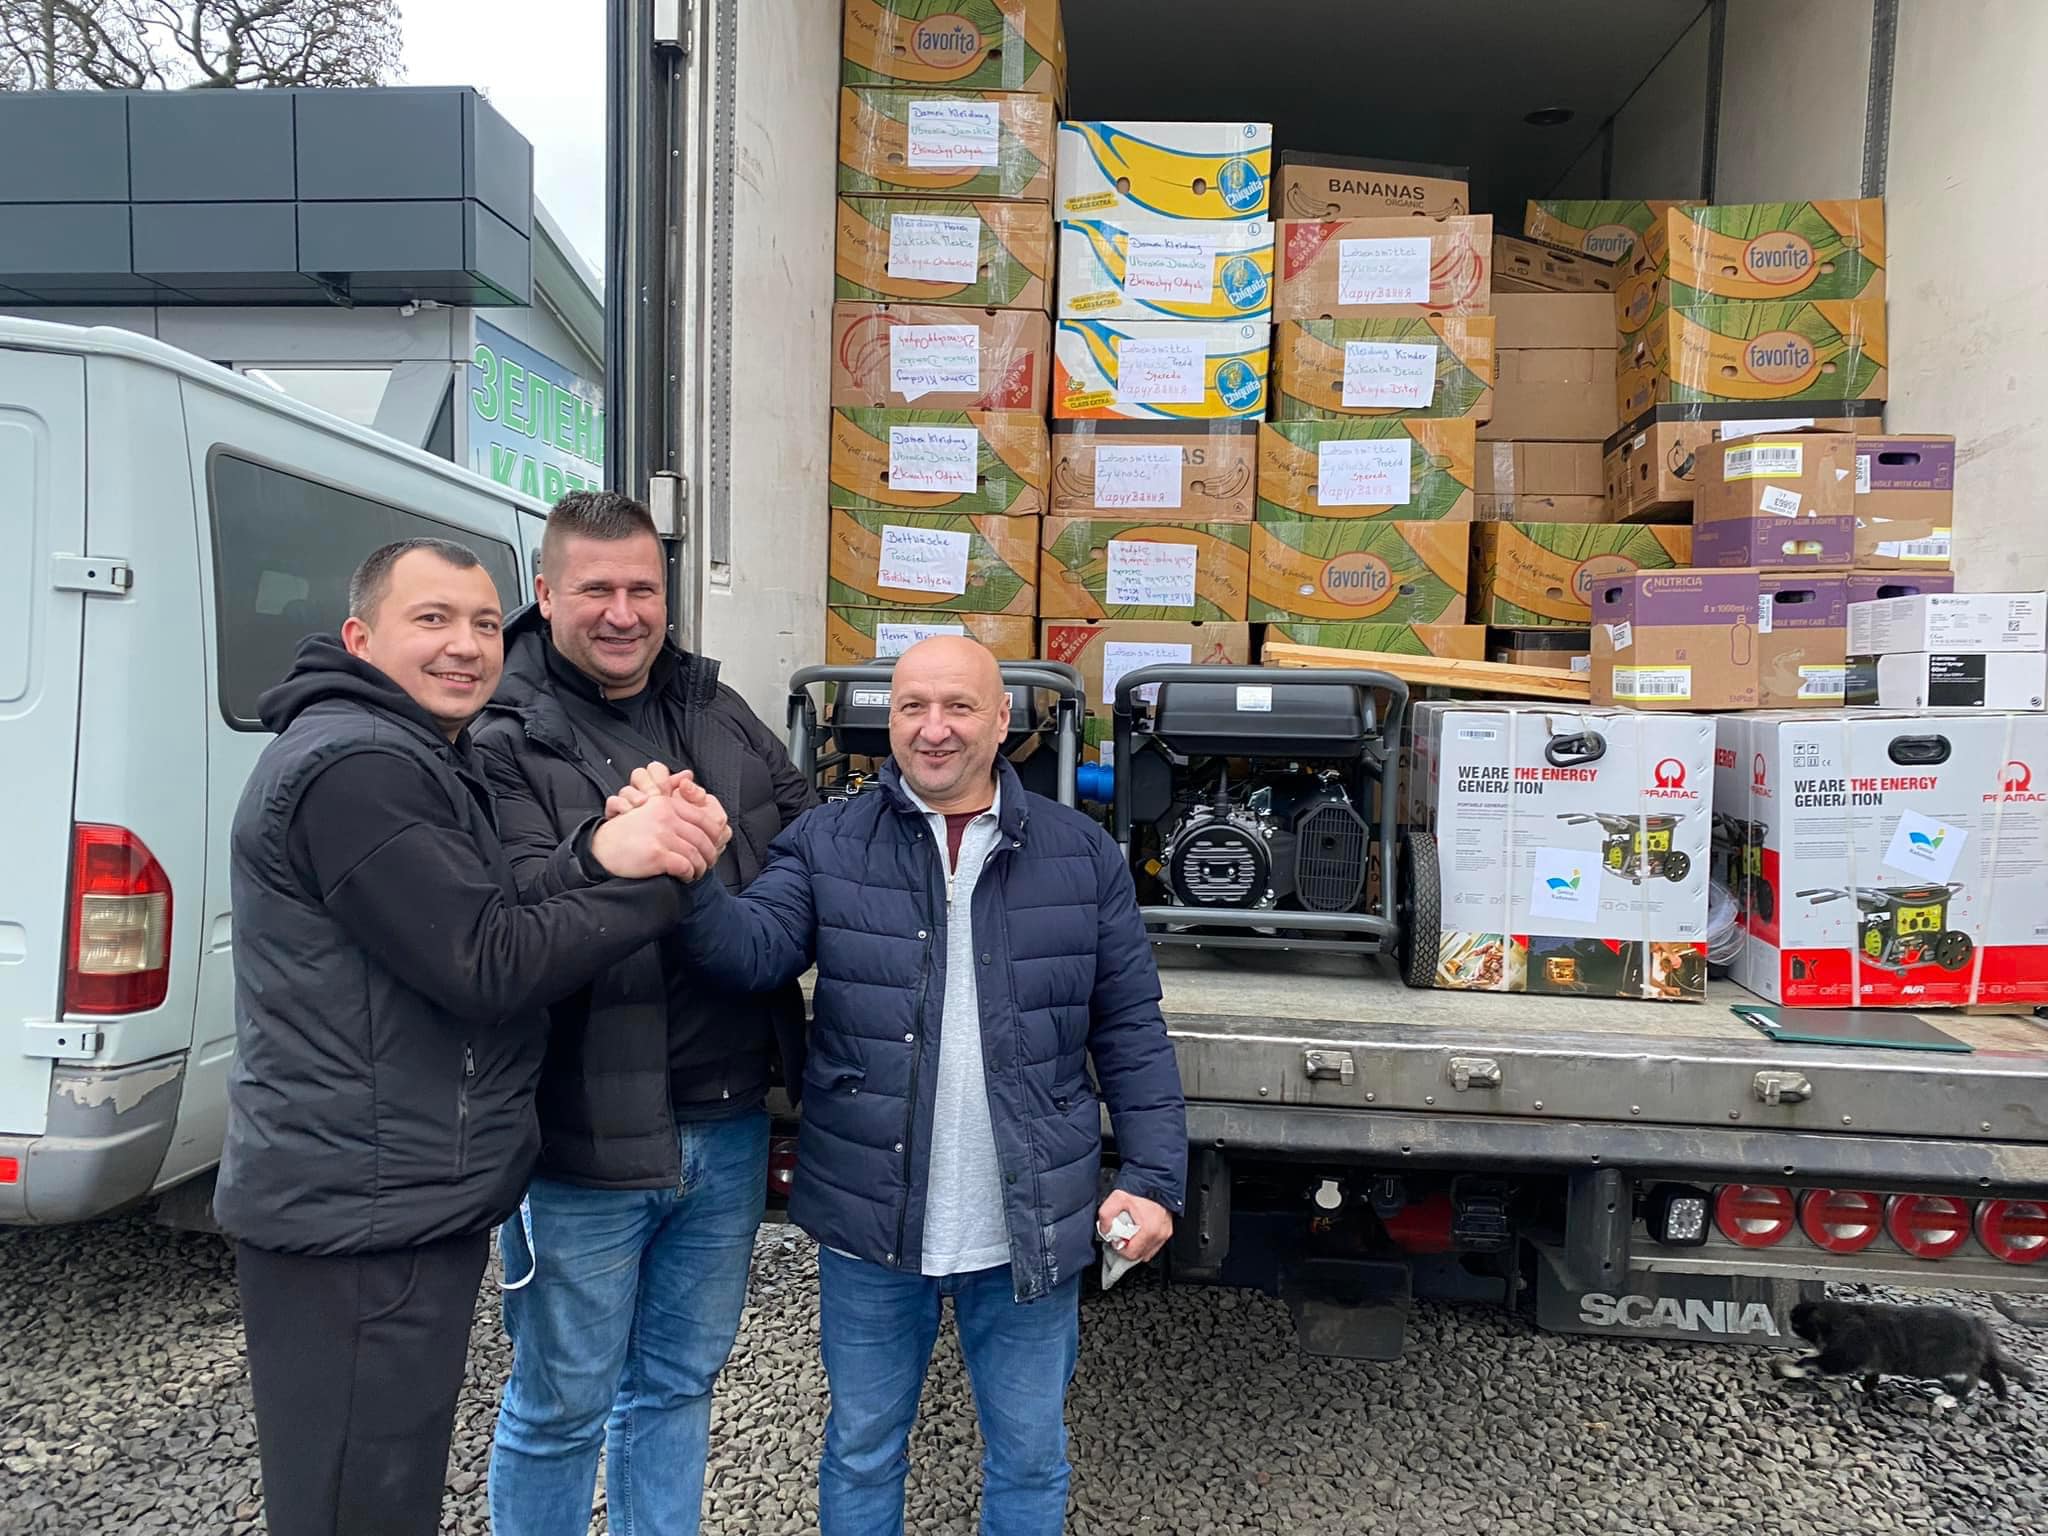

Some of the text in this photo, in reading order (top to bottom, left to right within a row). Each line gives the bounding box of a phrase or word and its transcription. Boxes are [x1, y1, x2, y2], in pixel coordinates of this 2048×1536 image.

[918, 27, 976, 54] favorita
[1226, 179, 1264, 207] Chiquita
[1328, 179, 1425, 201] BANANAS
[1385, 199, 1424, 209] ORGANIC
[1750, 246, 1808, 270] favorita
[1229, 277, 1267, 306] Chiquita
[1750, 345, 1809, 369] favorita
[1223, 379, 1261, 405] Chiquita
[472, 343, 604, 468] ЗЕЛЕН
[490, 442, 602, 508] КАР
[1327, 565, 1387, 591] favorita
[1654, 576, 1703, 587] NUTRICIA
[1458, 766, 1598, 782] WE ARE THE ENERGY
[1794, 776, 1937, 793] WE ARE THE ENERGY
[1640, 789, 1699, 799] PRAMAC
[1902, 983, 1925, 995] AVR
[1579, 1293, 1781, 1338] SCANIA
